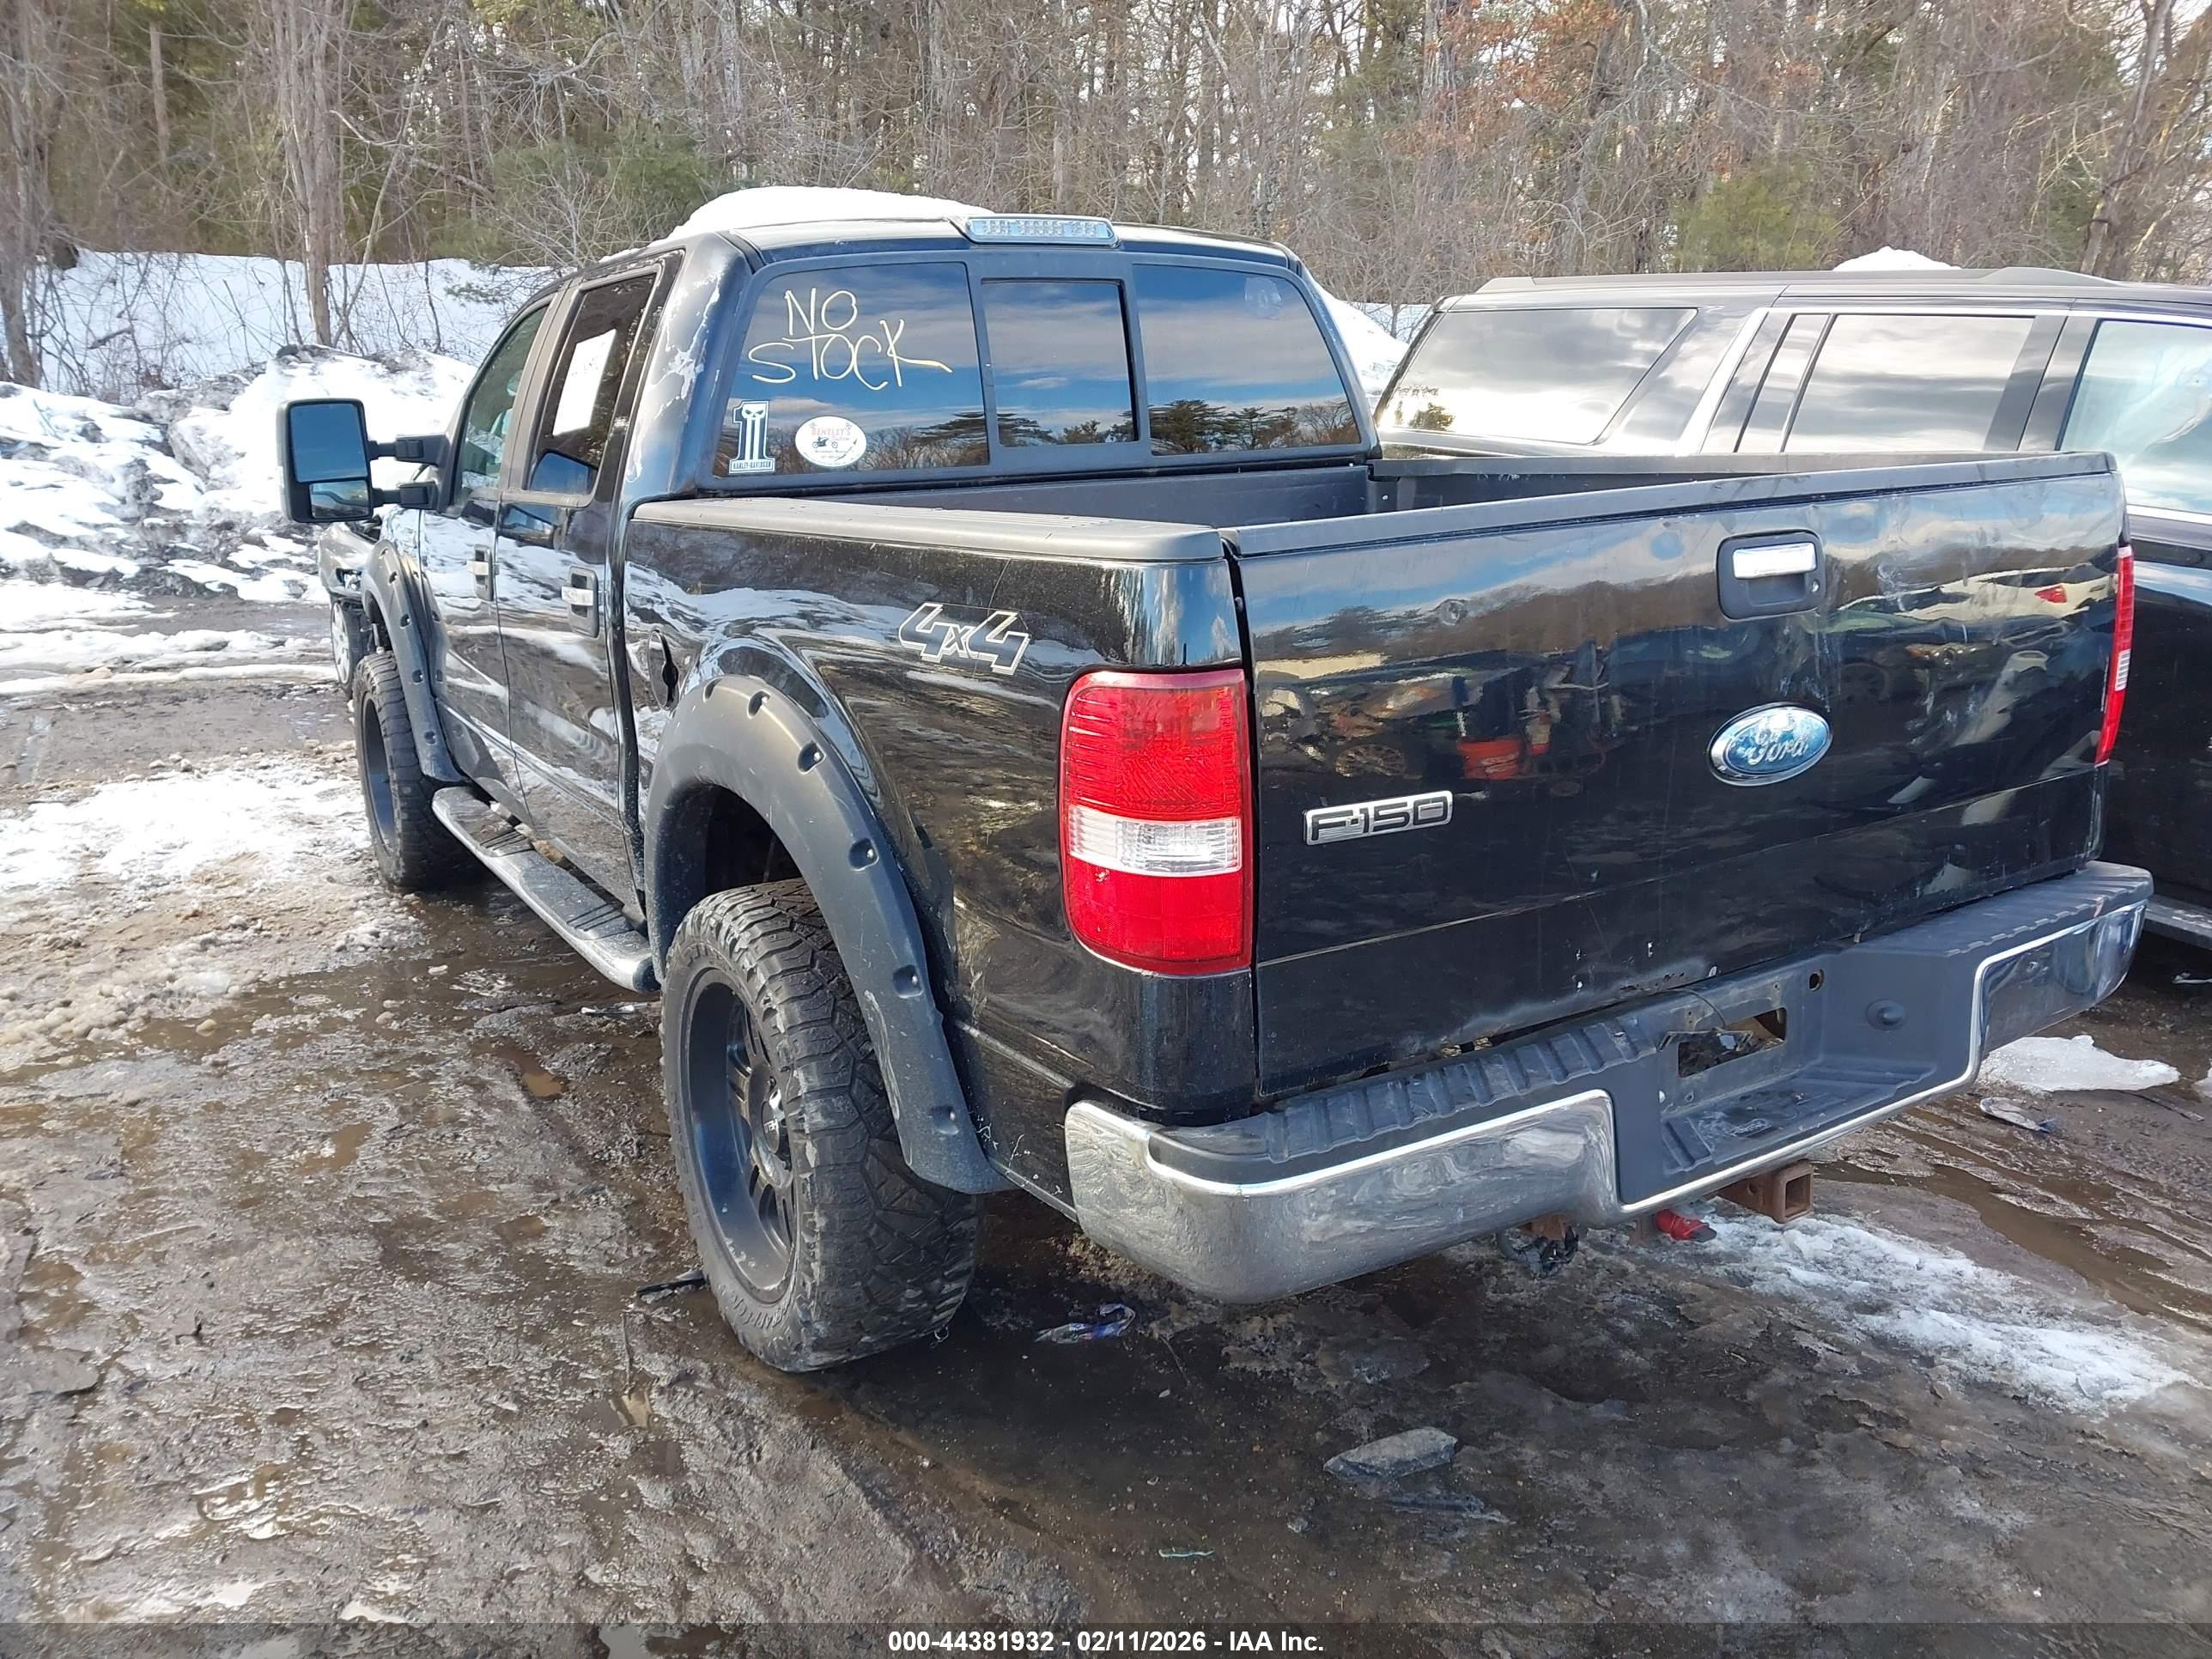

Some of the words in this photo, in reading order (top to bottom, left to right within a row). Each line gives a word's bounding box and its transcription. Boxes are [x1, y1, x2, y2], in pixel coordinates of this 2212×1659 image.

[784, 287, 858, 336] NO
[748, 319, 954, 391] STOCK
[1736, 722, 1809, 766] Ford
[1310, 795, 1450, 842] F-150
